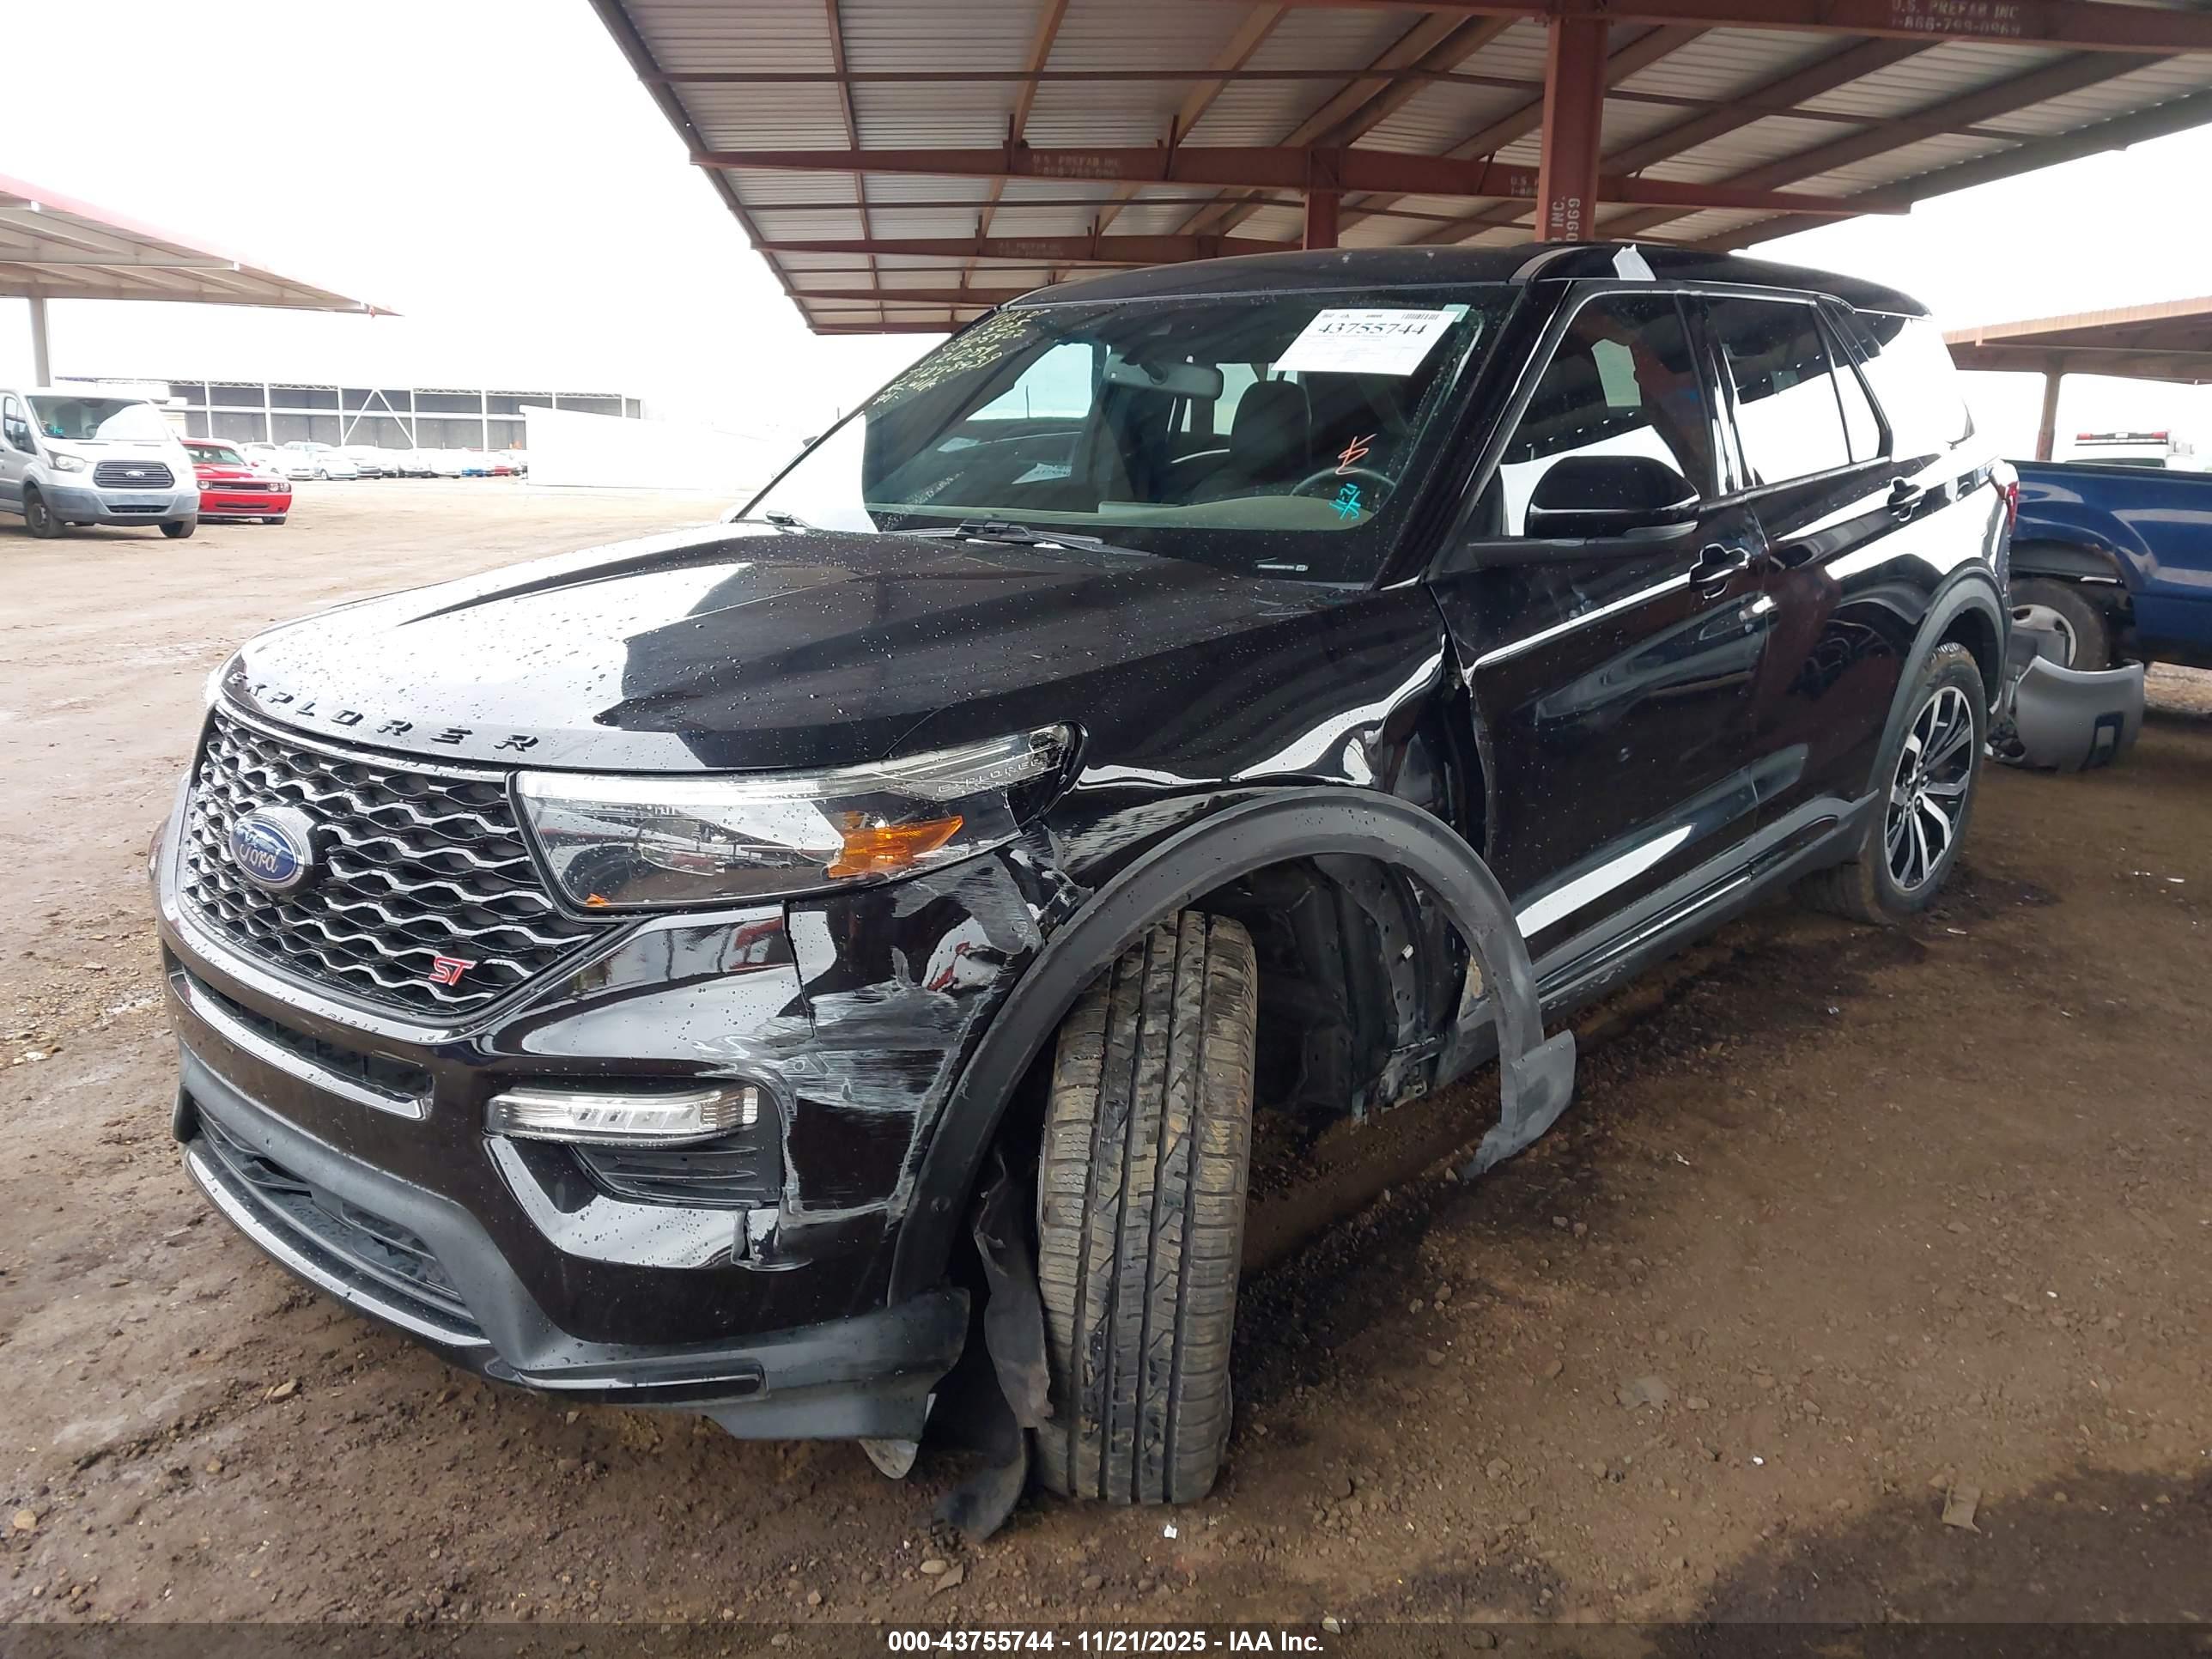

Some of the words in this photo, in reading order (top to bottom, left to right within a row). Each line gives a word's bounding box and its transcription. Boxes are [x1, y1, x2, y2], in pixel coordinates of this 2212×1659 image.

[1551, 196, 1566, 228] INC.
[1318, 322, 1428, 335] 43755744
[228, 671, 539, 752] EXPLORER
[240, 833, 281, 873] Ford
[428, 955, 478, 987] ST
